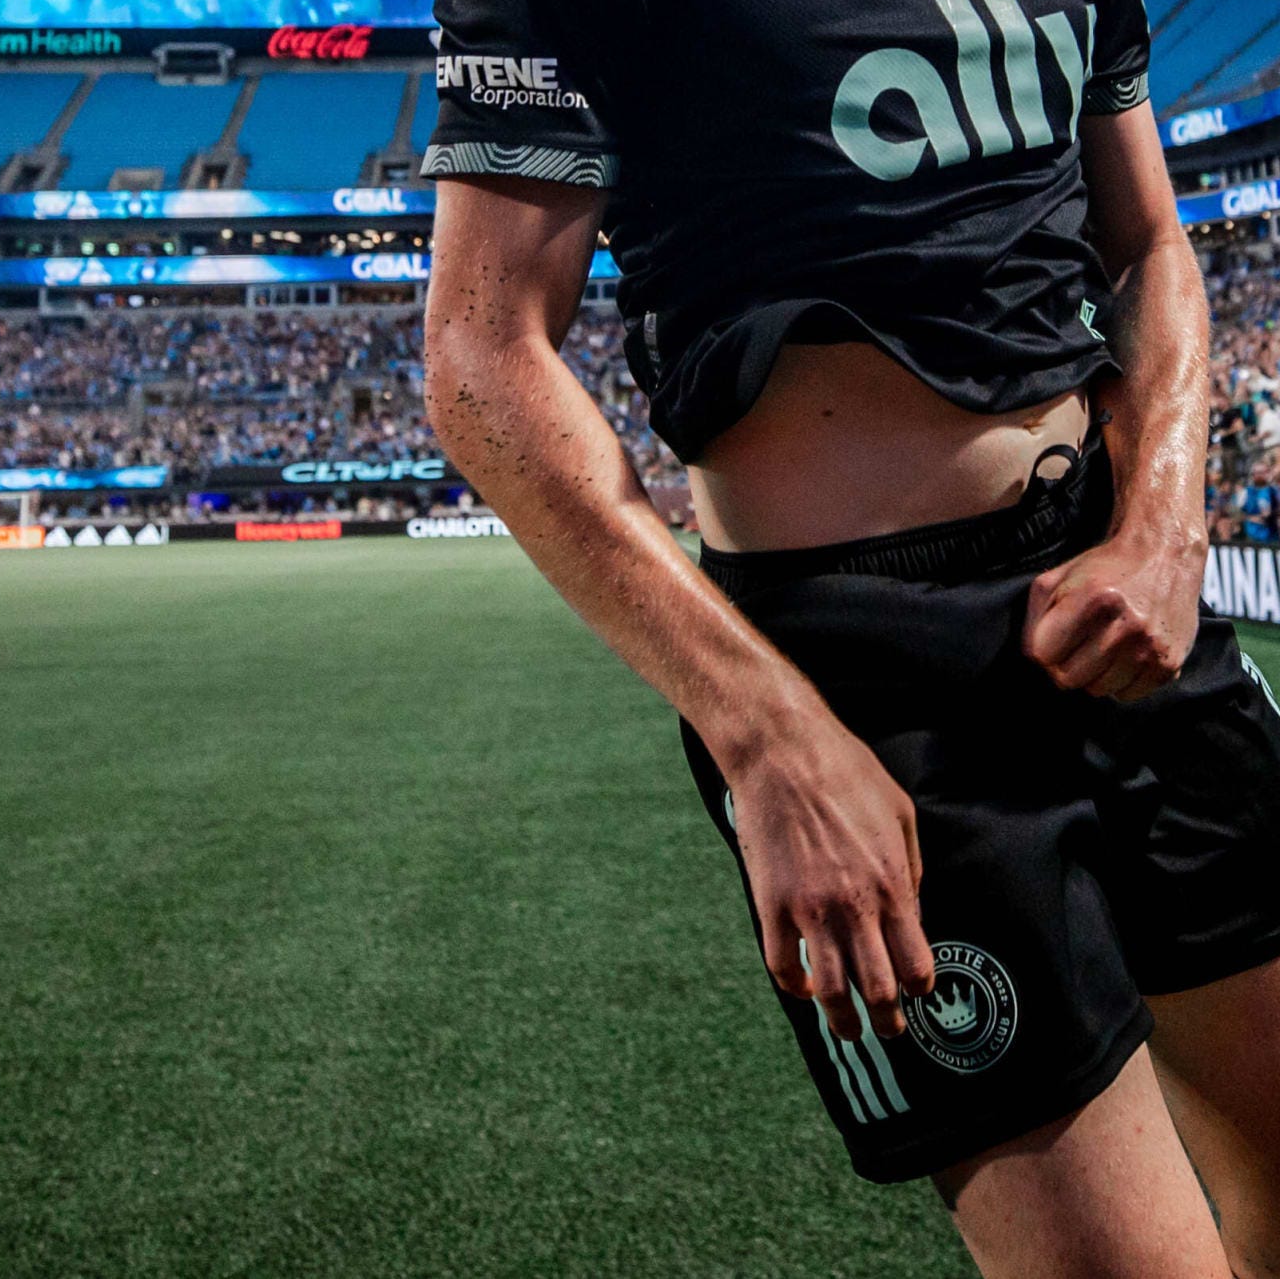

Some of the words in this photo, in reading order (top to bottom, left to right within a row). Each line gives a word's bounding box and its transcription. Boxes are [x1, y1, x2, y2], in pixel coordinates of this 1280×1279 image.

[31, 29, 121, 55] Health
[436, 55, 559, 89] ENTENE
[470, 84, 590, 110] Corporation
[1170, 108, 1228, 146] GOAL
[333, 188, 407, 213] GOAL
[351, 253, 429, 279] GOAL
